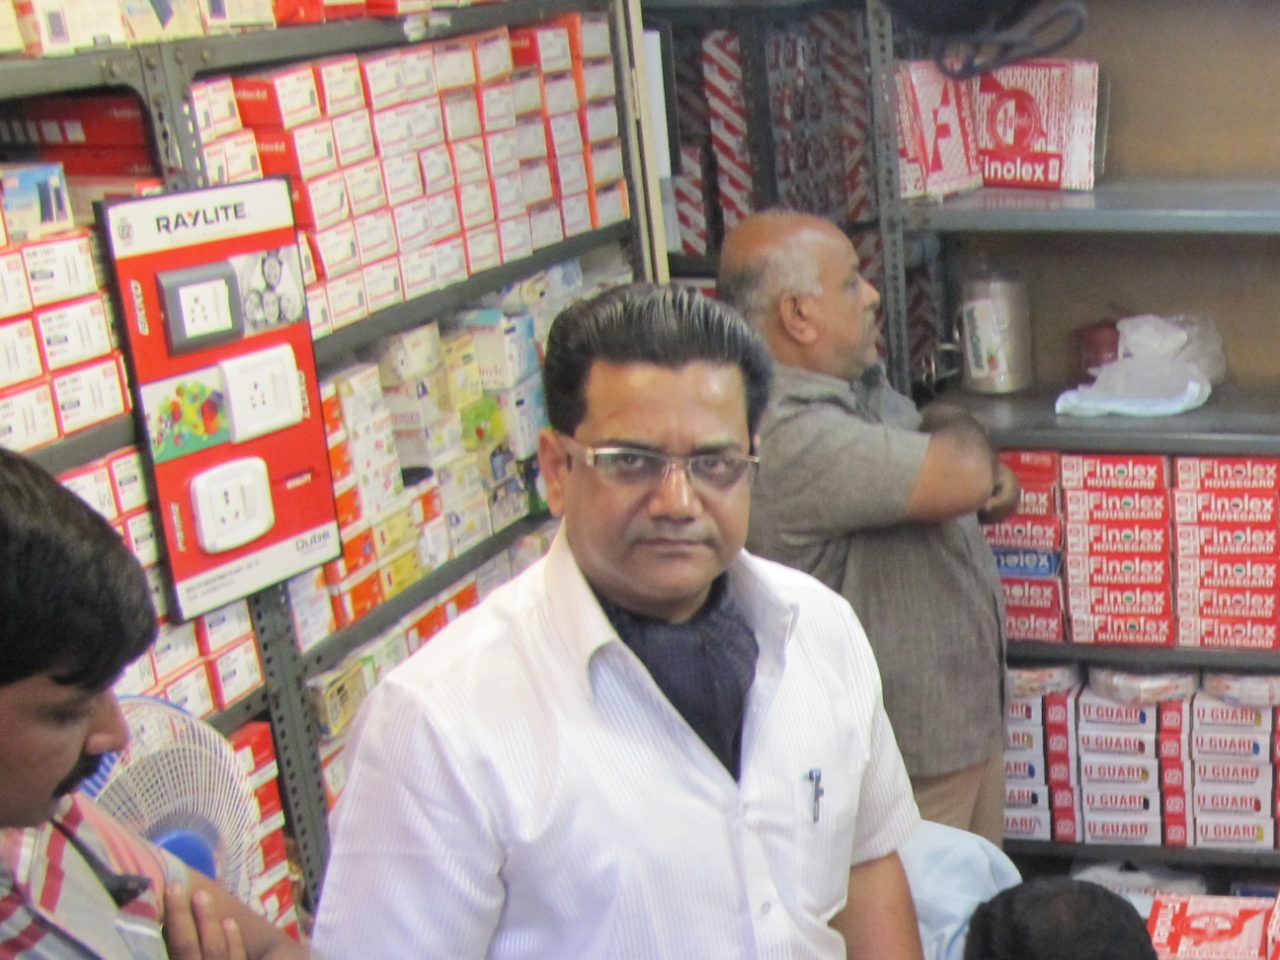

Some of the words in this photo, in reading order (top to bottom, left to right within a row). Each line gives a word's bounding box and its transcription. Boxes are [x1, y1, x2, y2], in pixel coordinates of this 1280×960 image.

[156, 202, 247, 234] RAYLITE
[1083, 458, 1157, 479] Finolex
[1200, 459, 1277, 479] Finolex
[1087, 477, 1155, 489] HOUSEGARD
[1204, 478, 1275, 489] HOUSEGARD
[1089, 491, 1164, 510] Finolex
[1197, 493, 1274, 512] Finolex
[1094, 509, 1162, 520] HOUSEGARD
[1201, 511, 1271, 523] HOUSEGARD
[1199, 559, 1276, 578] Finolex
[1204, 577, 1274, 588] HOUSEGARD
[1090, 586, 1165, 606] Finolex
[1095, 603, 1162, 614] HOUSEGARD
[1212, 766, 1259, 779] GUARD
[1101, 822, 1148, 836] GUARD
